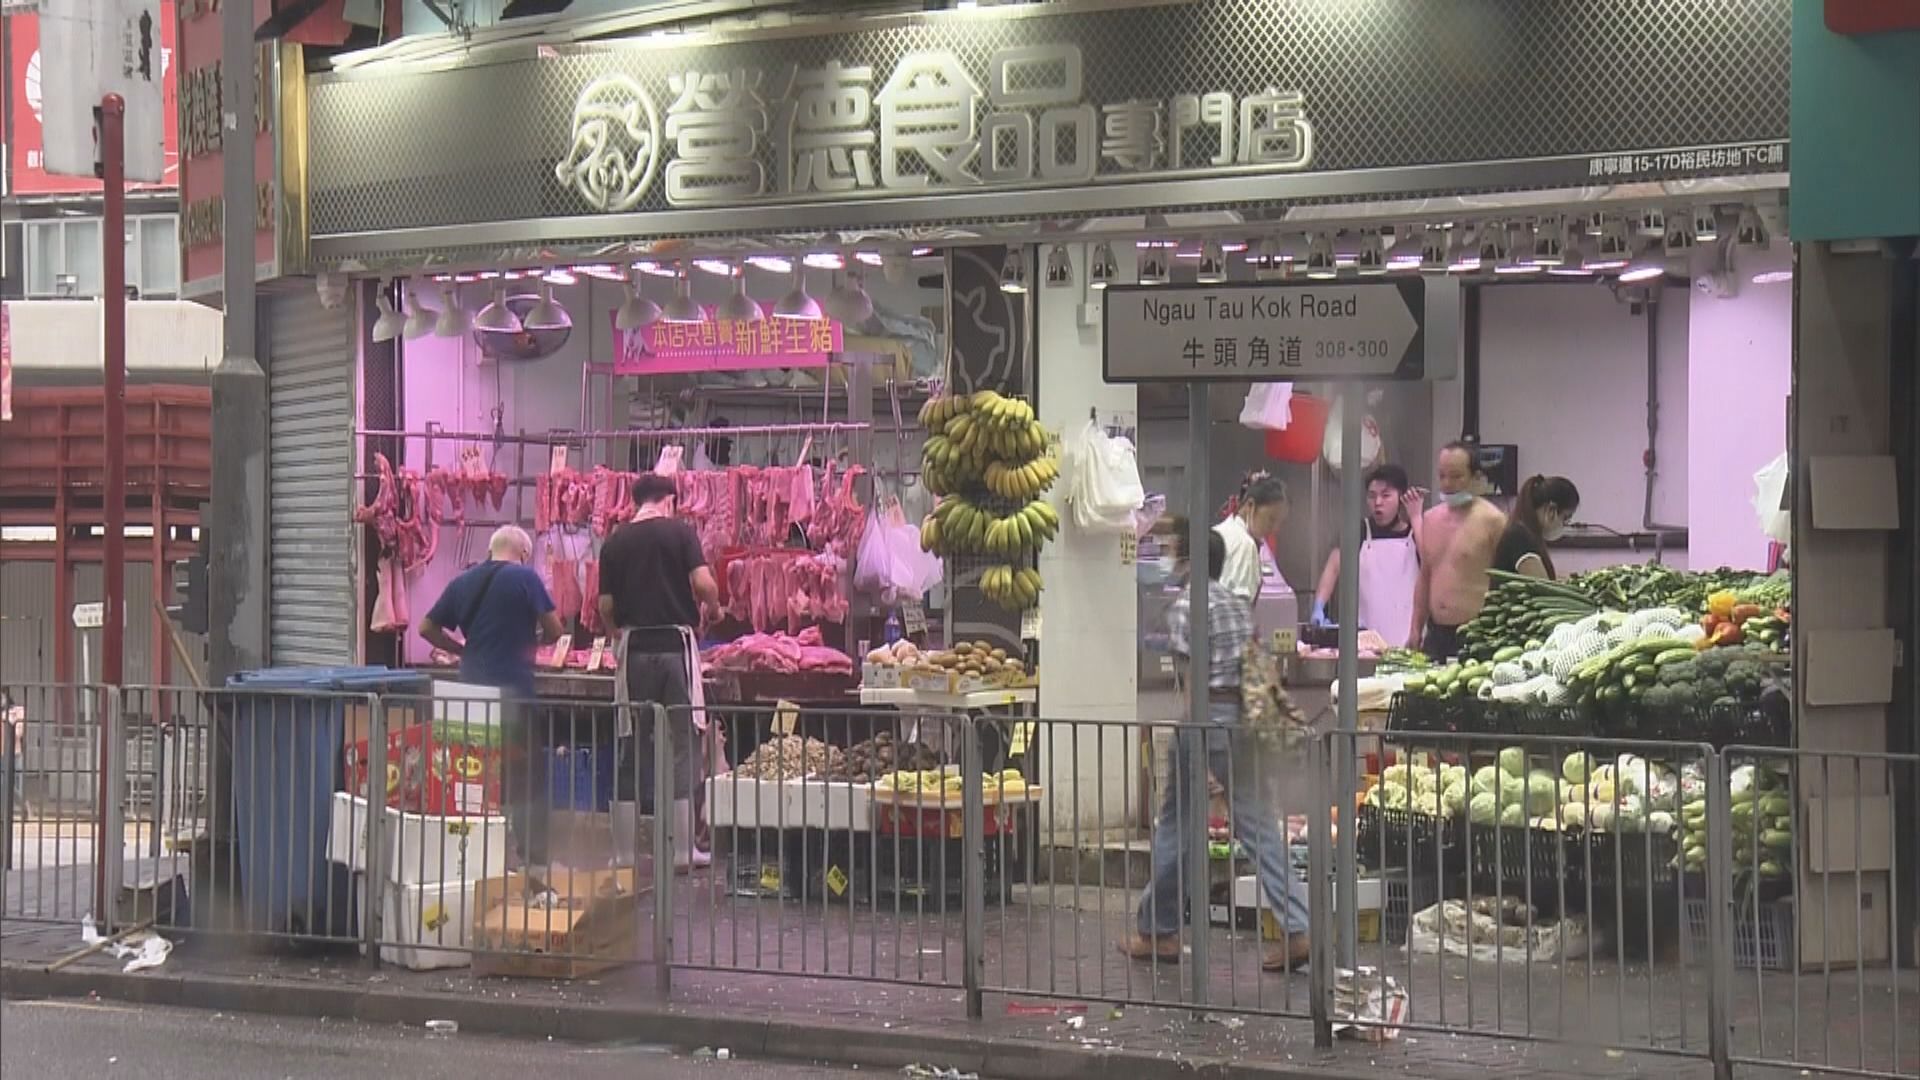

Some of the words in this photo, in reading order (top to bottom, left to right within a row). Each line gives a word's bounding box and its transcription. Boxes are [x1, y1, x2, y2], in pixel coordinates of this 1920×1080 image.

[1143, 298, 1196, 326] Ngau
[1204, 296, 1244, 320] Tau
[1252, 294, 1292, 319] Kok
[1300, 293, 1358, 318] Road
[1182, 335, 1303, 368] 牛頭角道
